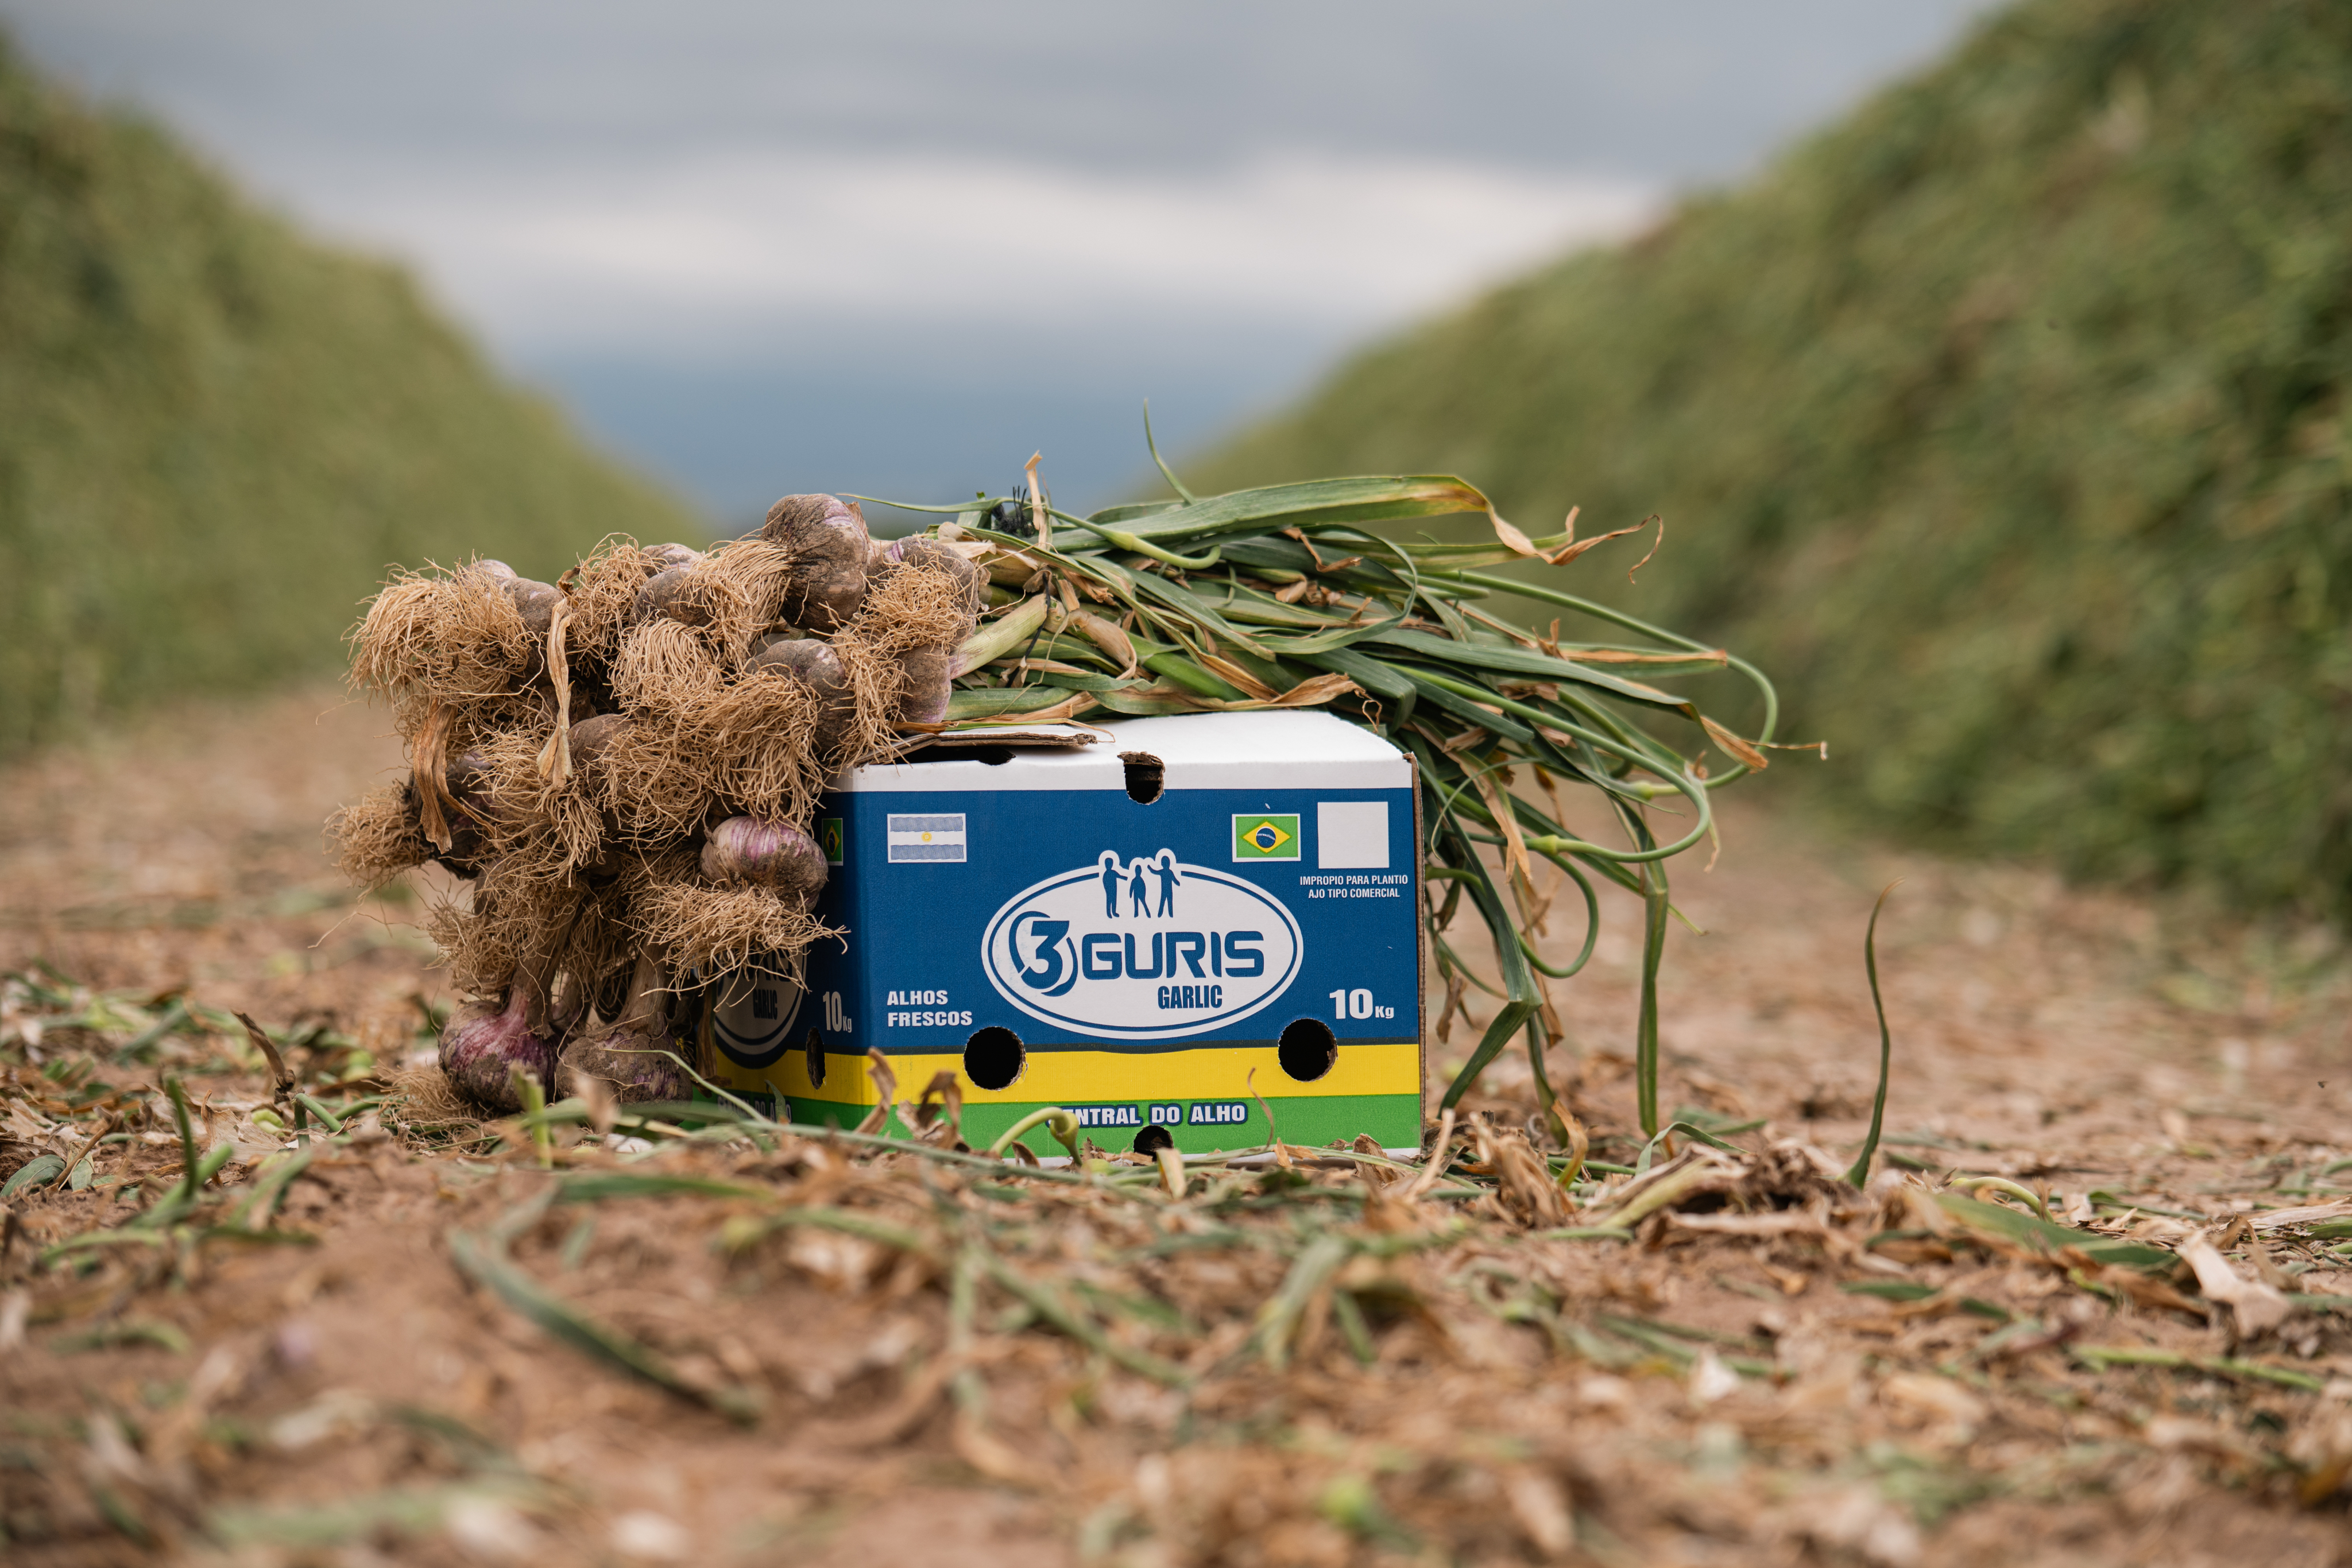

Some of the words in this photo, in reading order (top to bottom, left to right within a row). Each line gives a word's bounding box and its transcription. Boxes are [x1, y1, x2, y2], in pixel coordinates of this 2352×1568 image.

[1299, 876, 1344, 885] IMPROPIO
[1346, 875, 1370, 885] PARA
[1371, 874, 1408, 885] PLANTIO
[1308, 889, 1325, 899] AJO
[1328, 889, 1347, 898] TIPO
[1350, 888, 1400, 898] COMERCIAL
[1082, 931, 1264, 980] GURIS
[752, 988, 778, 1020] GARLIC
[887, 990, 948, 1005] ALHOS
[1158, 985, 1223, 1009] GARLIC
[888, 1011, 973, 1027] FRESCOS
[1047, 1106, 1142, 1125] NTRAL
[1151, 1106, 1181, 1124] DO
[1190, 1104, 1245, 1122] ALHO
